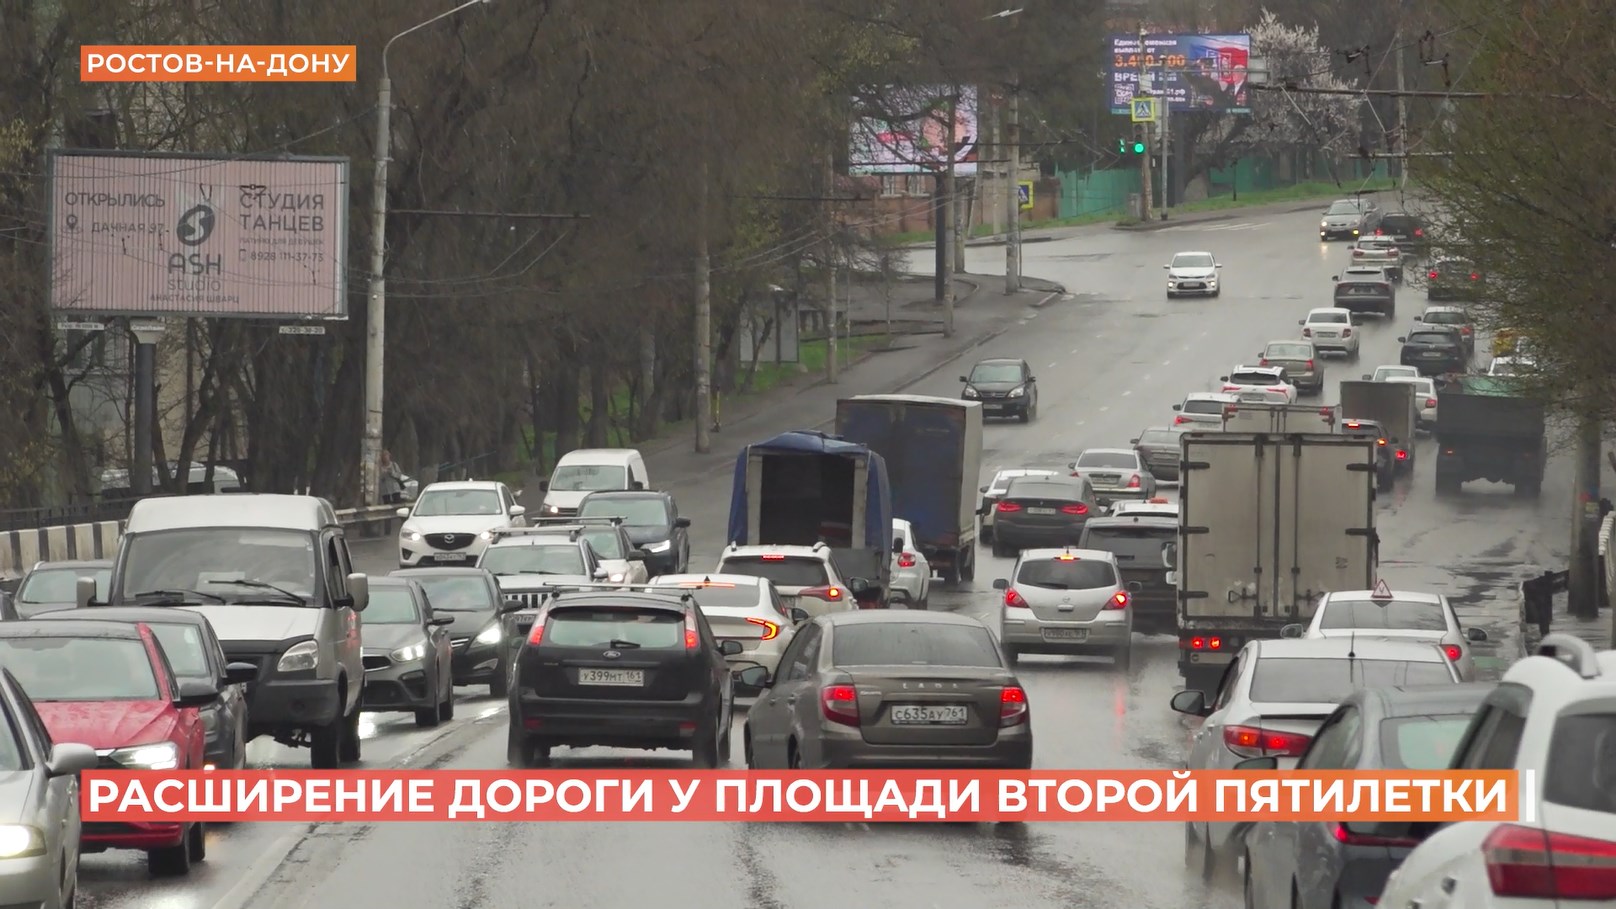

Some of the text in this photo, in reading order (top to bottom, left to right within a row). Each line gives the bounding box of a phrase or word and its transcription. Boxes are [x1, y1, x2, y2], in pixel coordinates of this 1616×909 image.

[65, 192, 165, 207] ОТКРЫЛИСЬ
[239, 192, 324, 212] СТУДИЯ
[92, 222, 145, 233] ДАЧНАЯ
[239, 214, 324, 234] ТАНЦЕВ
[250, 251, 276, 261] 8928
[168, 253, 221, 275] ASH
[168, 276, 221, 291] studio
